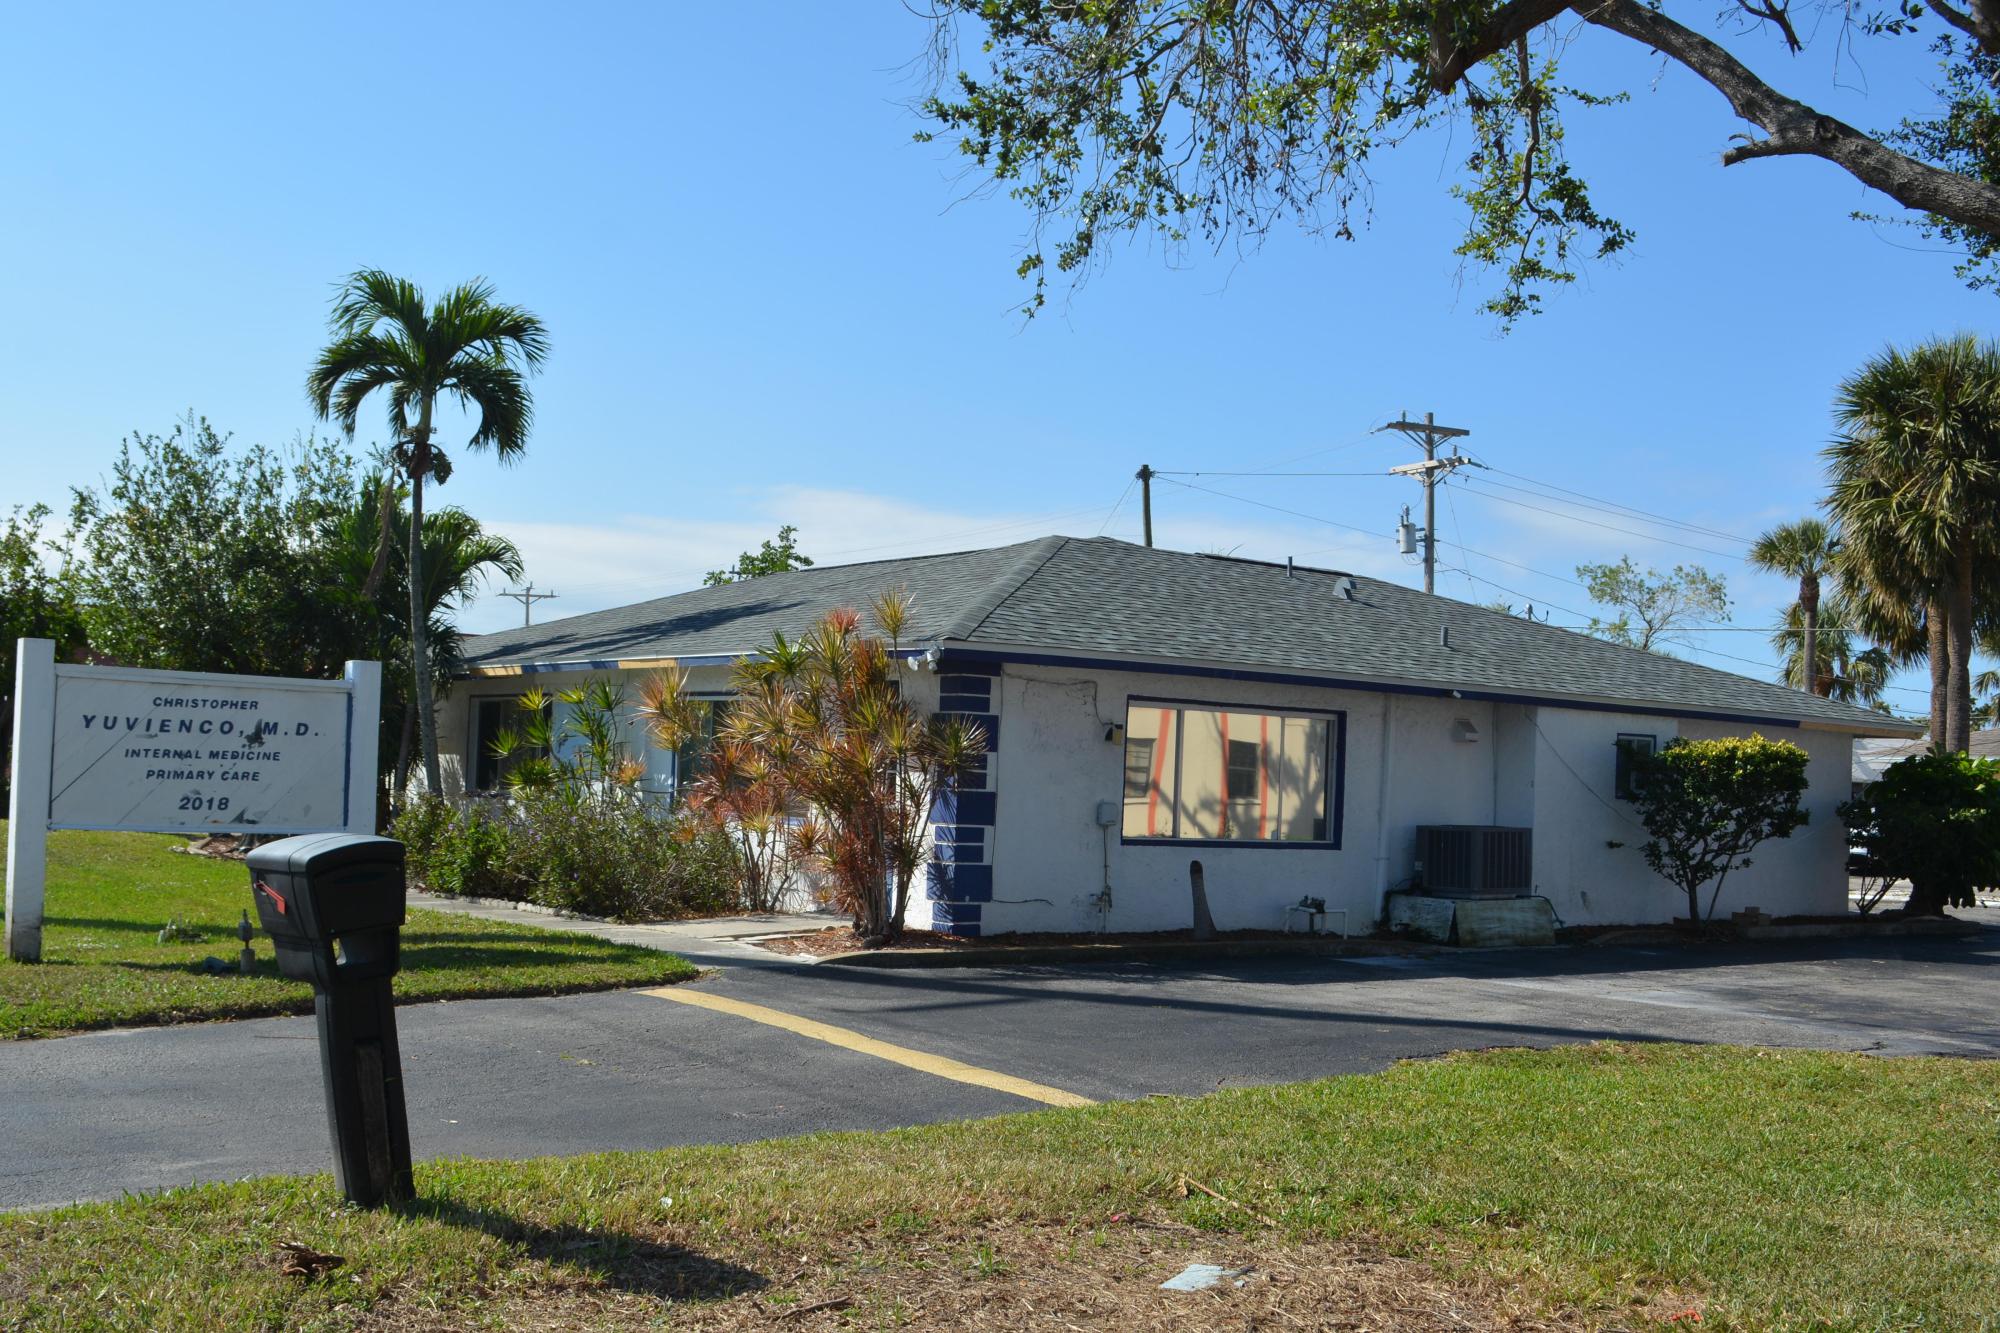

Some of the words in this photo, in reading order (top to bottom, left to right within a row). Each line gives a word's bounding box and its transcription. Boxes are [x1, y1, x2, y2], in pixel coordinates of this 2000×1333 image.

[153, 696, 259, 710] CHRISTOPHER
[82, 714, 245, 738] YUVIENCO,
[262, 721, 319, 737] M.D.
[124, 748, 202, 760] INTERNAL
[208, 749, 281, 761] MEDICINE
[146, 769, 215, 781] PRIMARY
[221, 770, 260, 782] CARE
[178, 796, 230, 811] 2018
